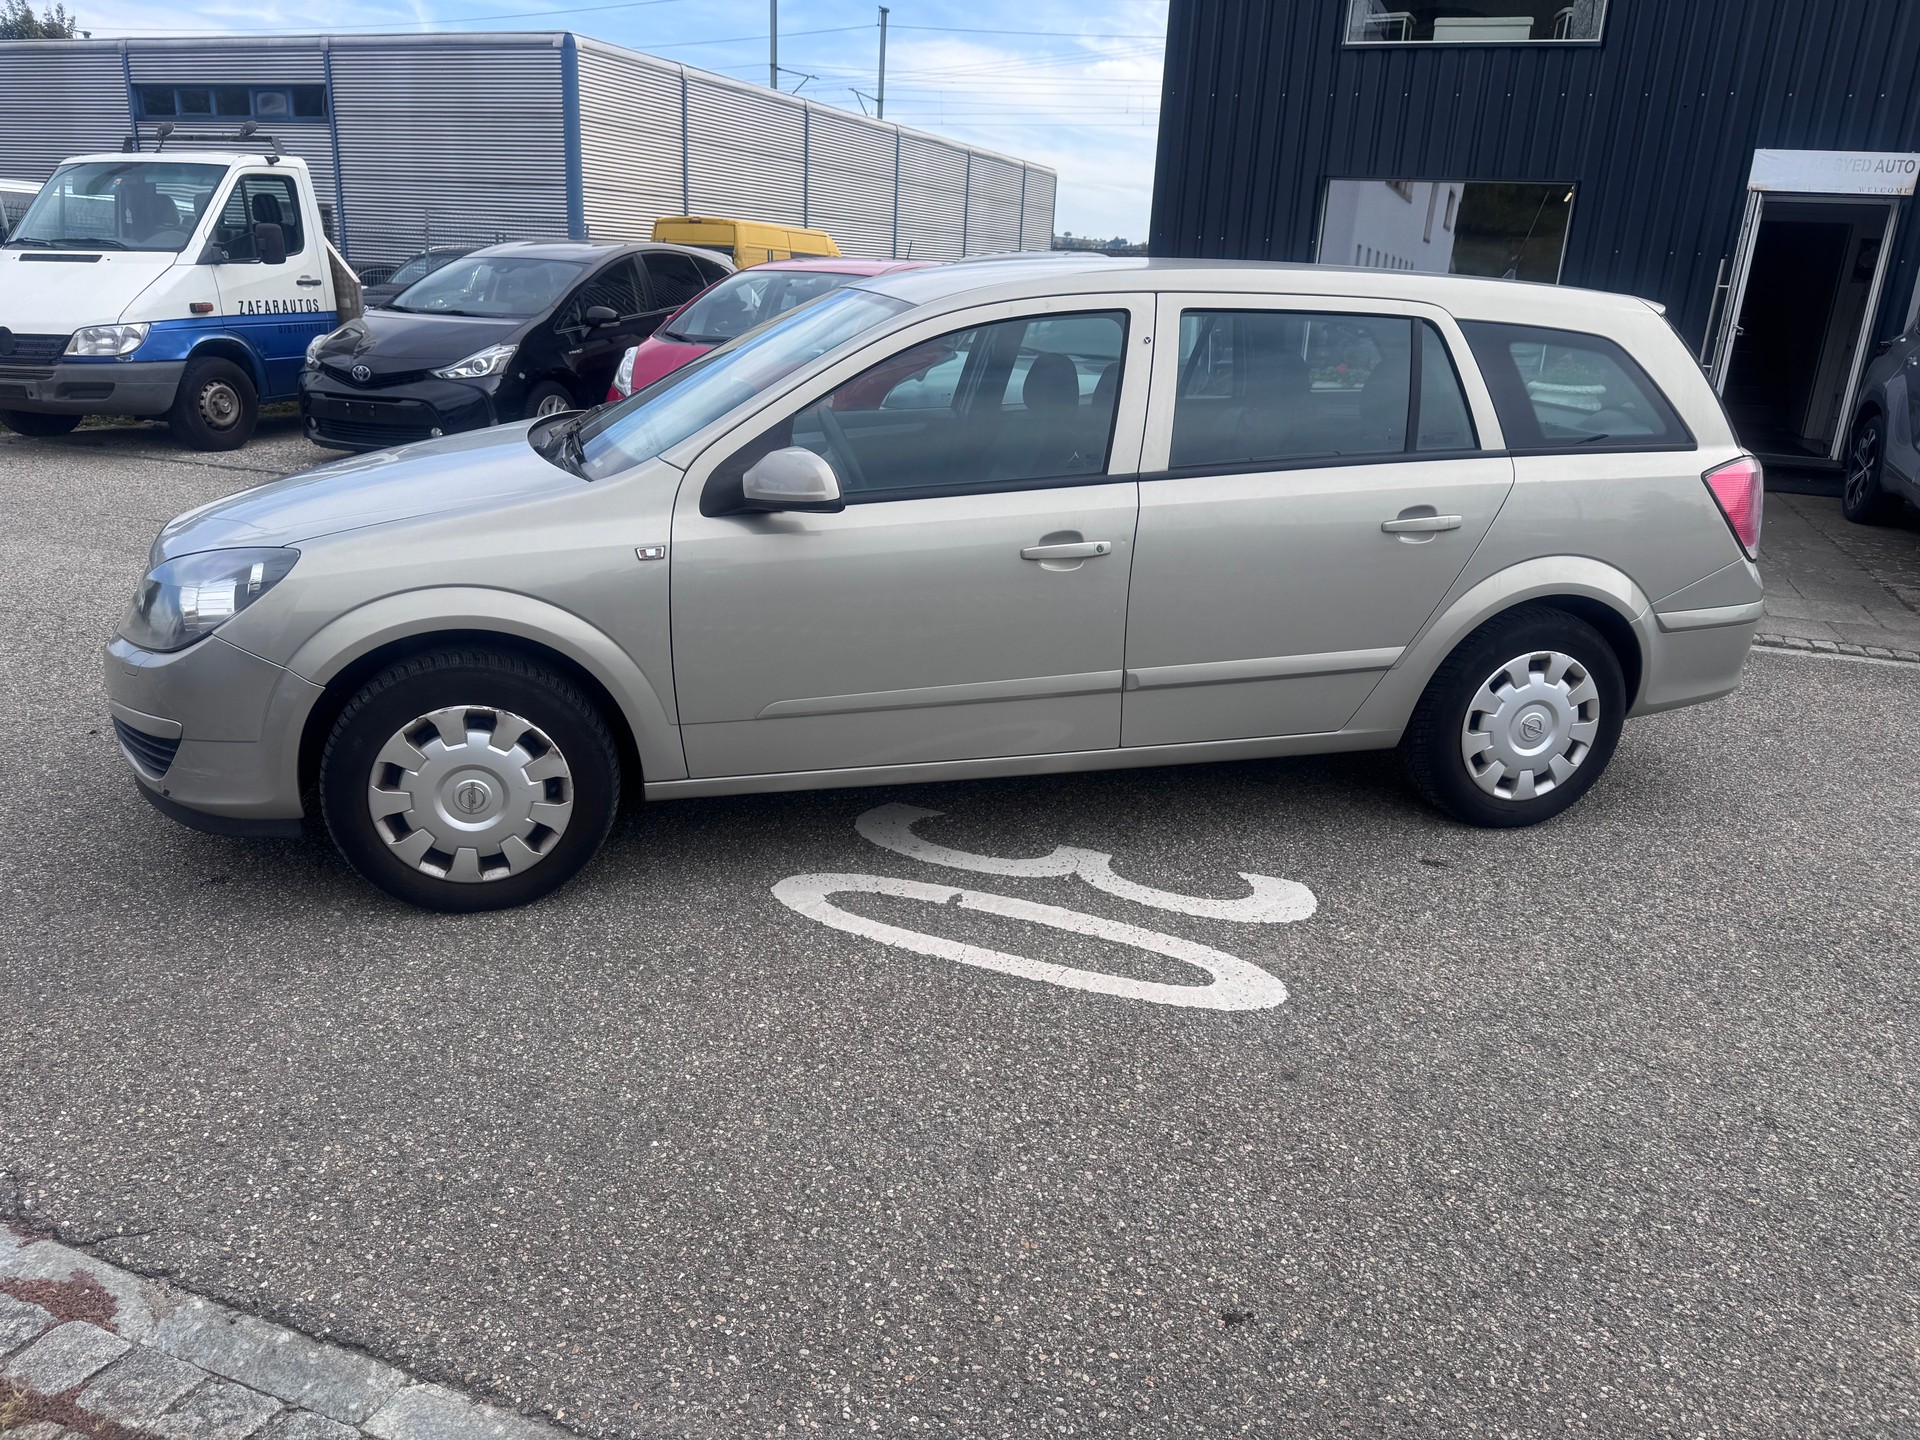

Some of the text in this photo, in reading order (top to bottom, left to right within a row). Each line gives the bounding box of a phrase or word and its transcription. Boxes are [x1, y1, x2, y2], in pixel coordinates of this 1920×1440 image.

[1874, 159, 1916, 174] AUTO
[1858, 186, 1911, 194] WELCOME
[238, 299, 320, 315] ZAFARAUTOS
